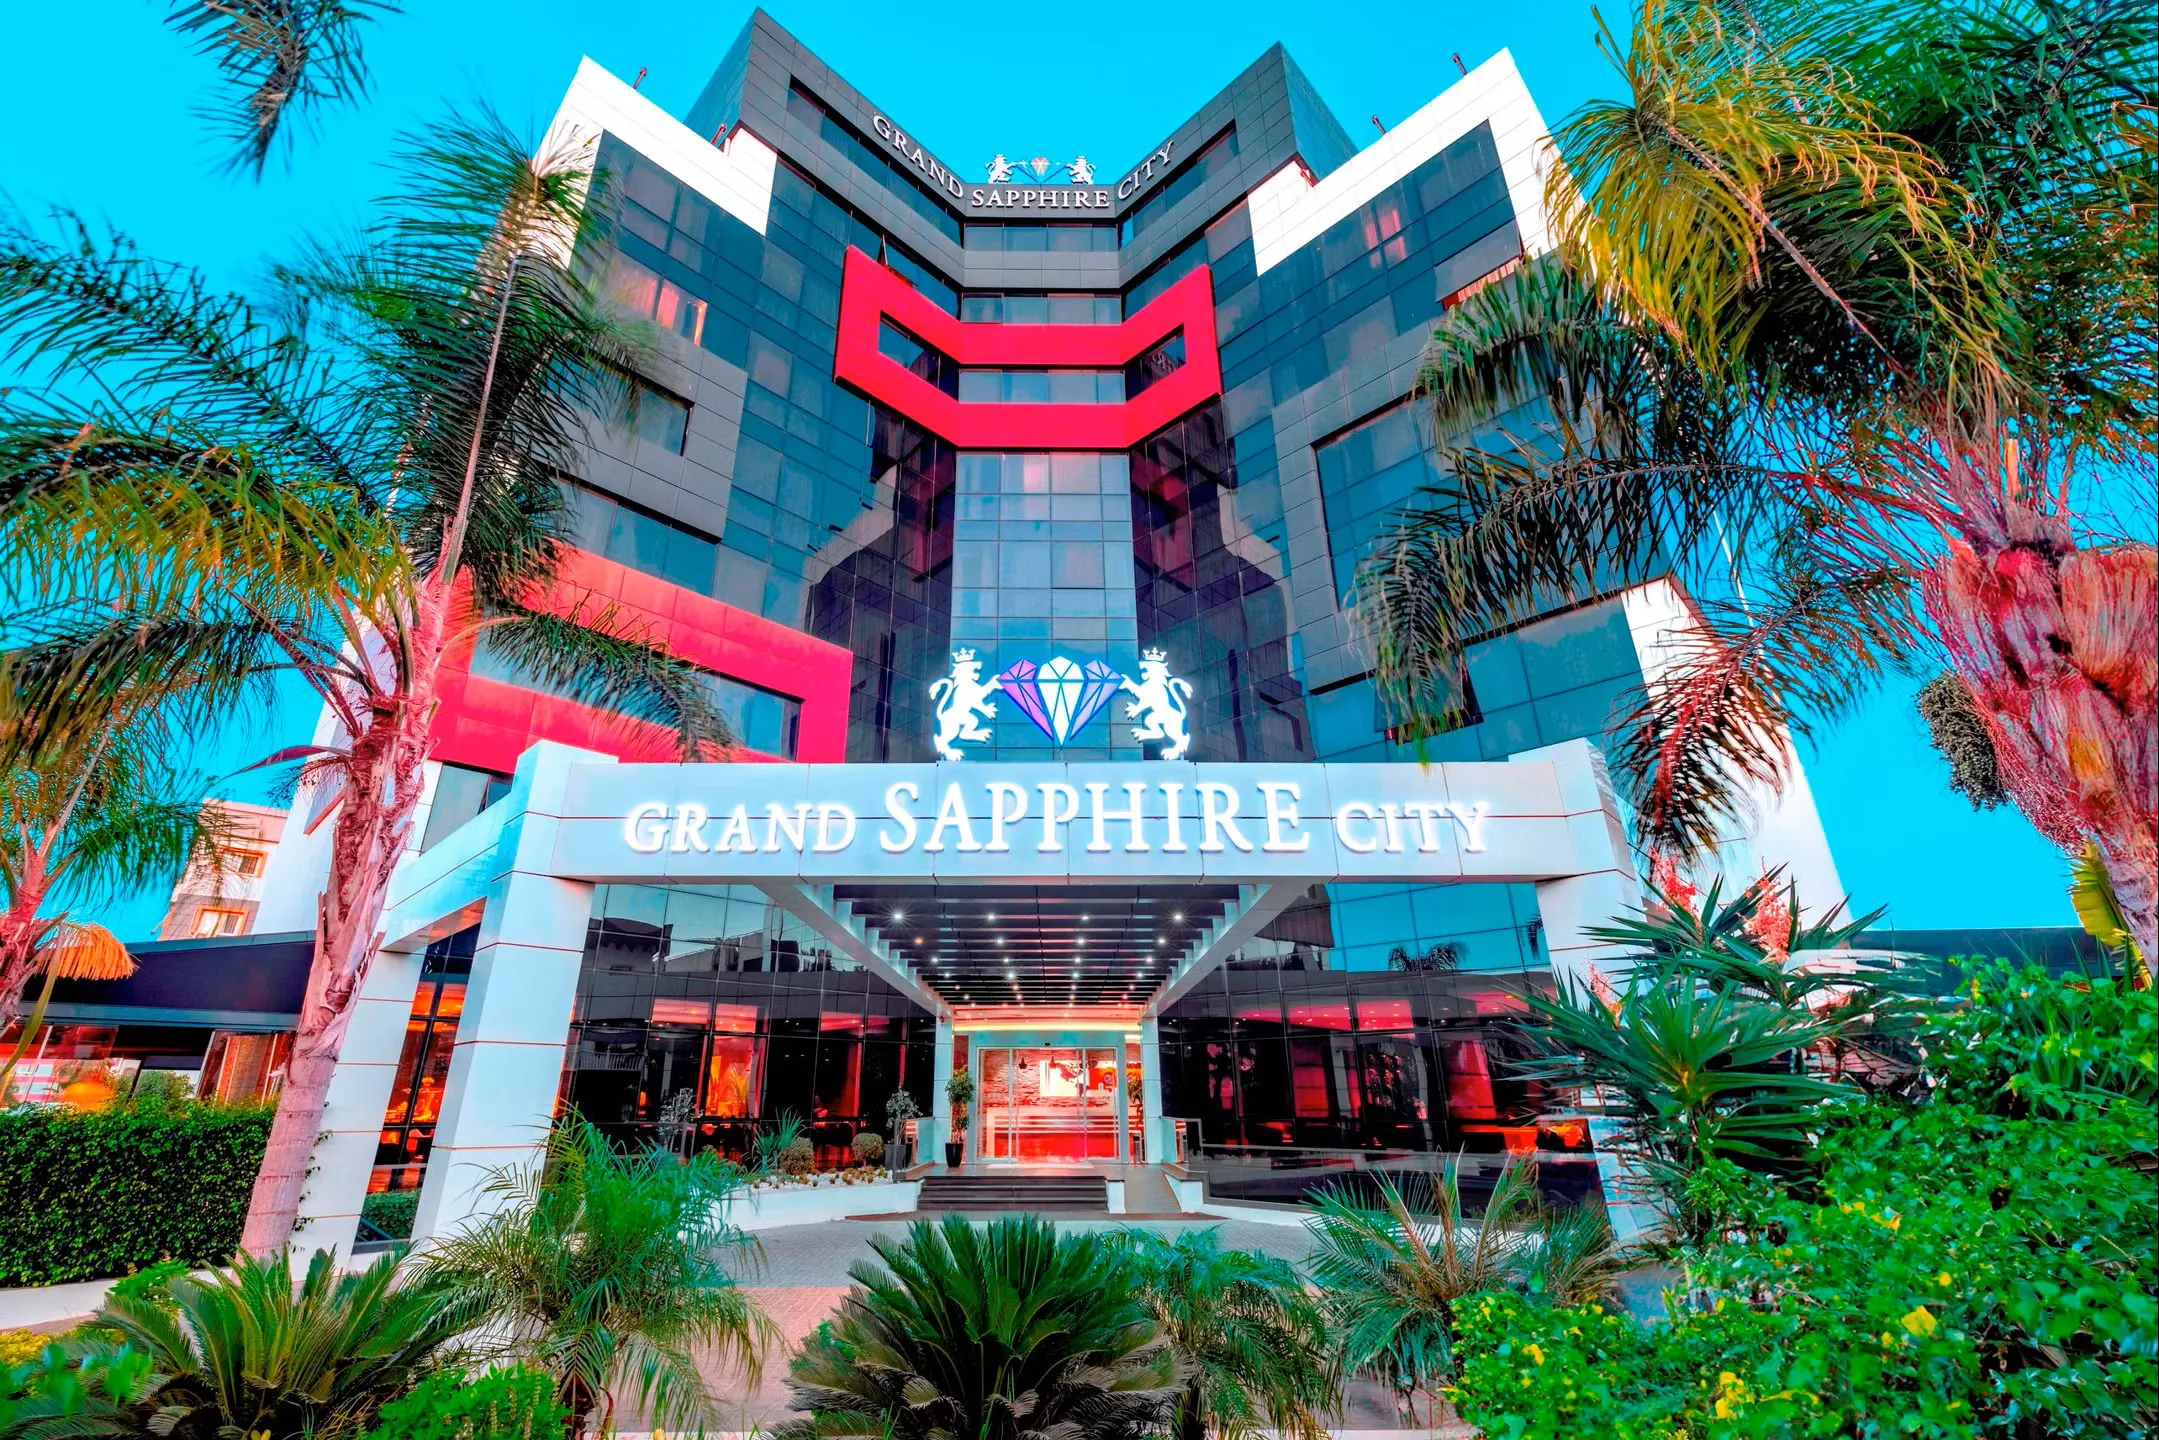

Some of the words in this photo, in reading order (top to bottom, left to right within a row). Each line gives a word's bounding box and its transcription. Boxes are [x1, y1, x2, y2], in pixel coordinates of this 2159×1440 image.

[872, 114, 963, 198] GRAND
[971, 189, 1110, 208] SAPPHIRE
[1116, 140, 1175, 201] CITY
[623, 803, 858, 852] GRAND
[879, 782, 1310, 852] SAPPHIRE
[1335, 802, 1490, 852] CITY
